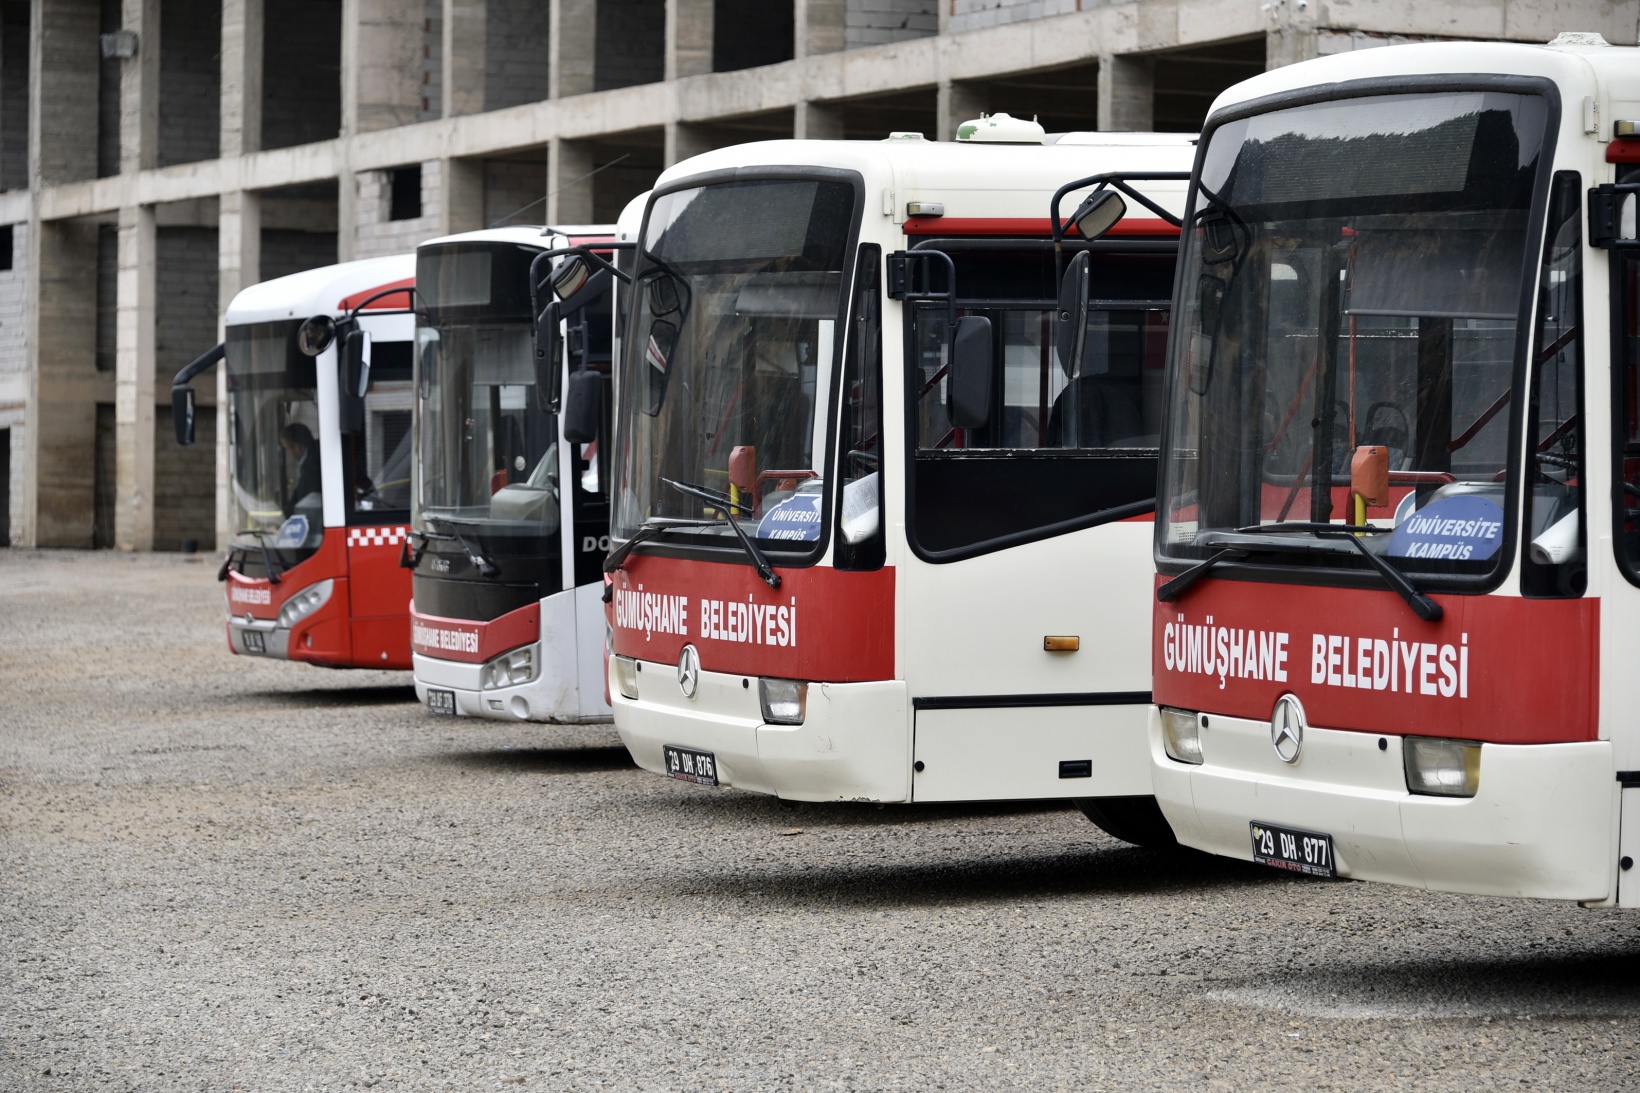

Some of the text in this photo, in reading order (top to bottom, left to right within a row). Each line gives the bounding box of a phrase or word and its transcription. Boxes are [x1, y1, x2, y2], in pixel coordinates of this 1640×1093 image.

[1406, 515, 1502, 539] ÜNİVERSİTE
[1405, 541, 1474, 560] KAMPÜS
[616, 582, 796, 647] GÜMÜŞHANE BELEDİYESİ
[1164, 613, 1468, 698] GÜMÜŞHANE BELEDİYESİ
[669, 750, 680, 771] 29
[1259, 829, 1327, 866] 29 DH 877
